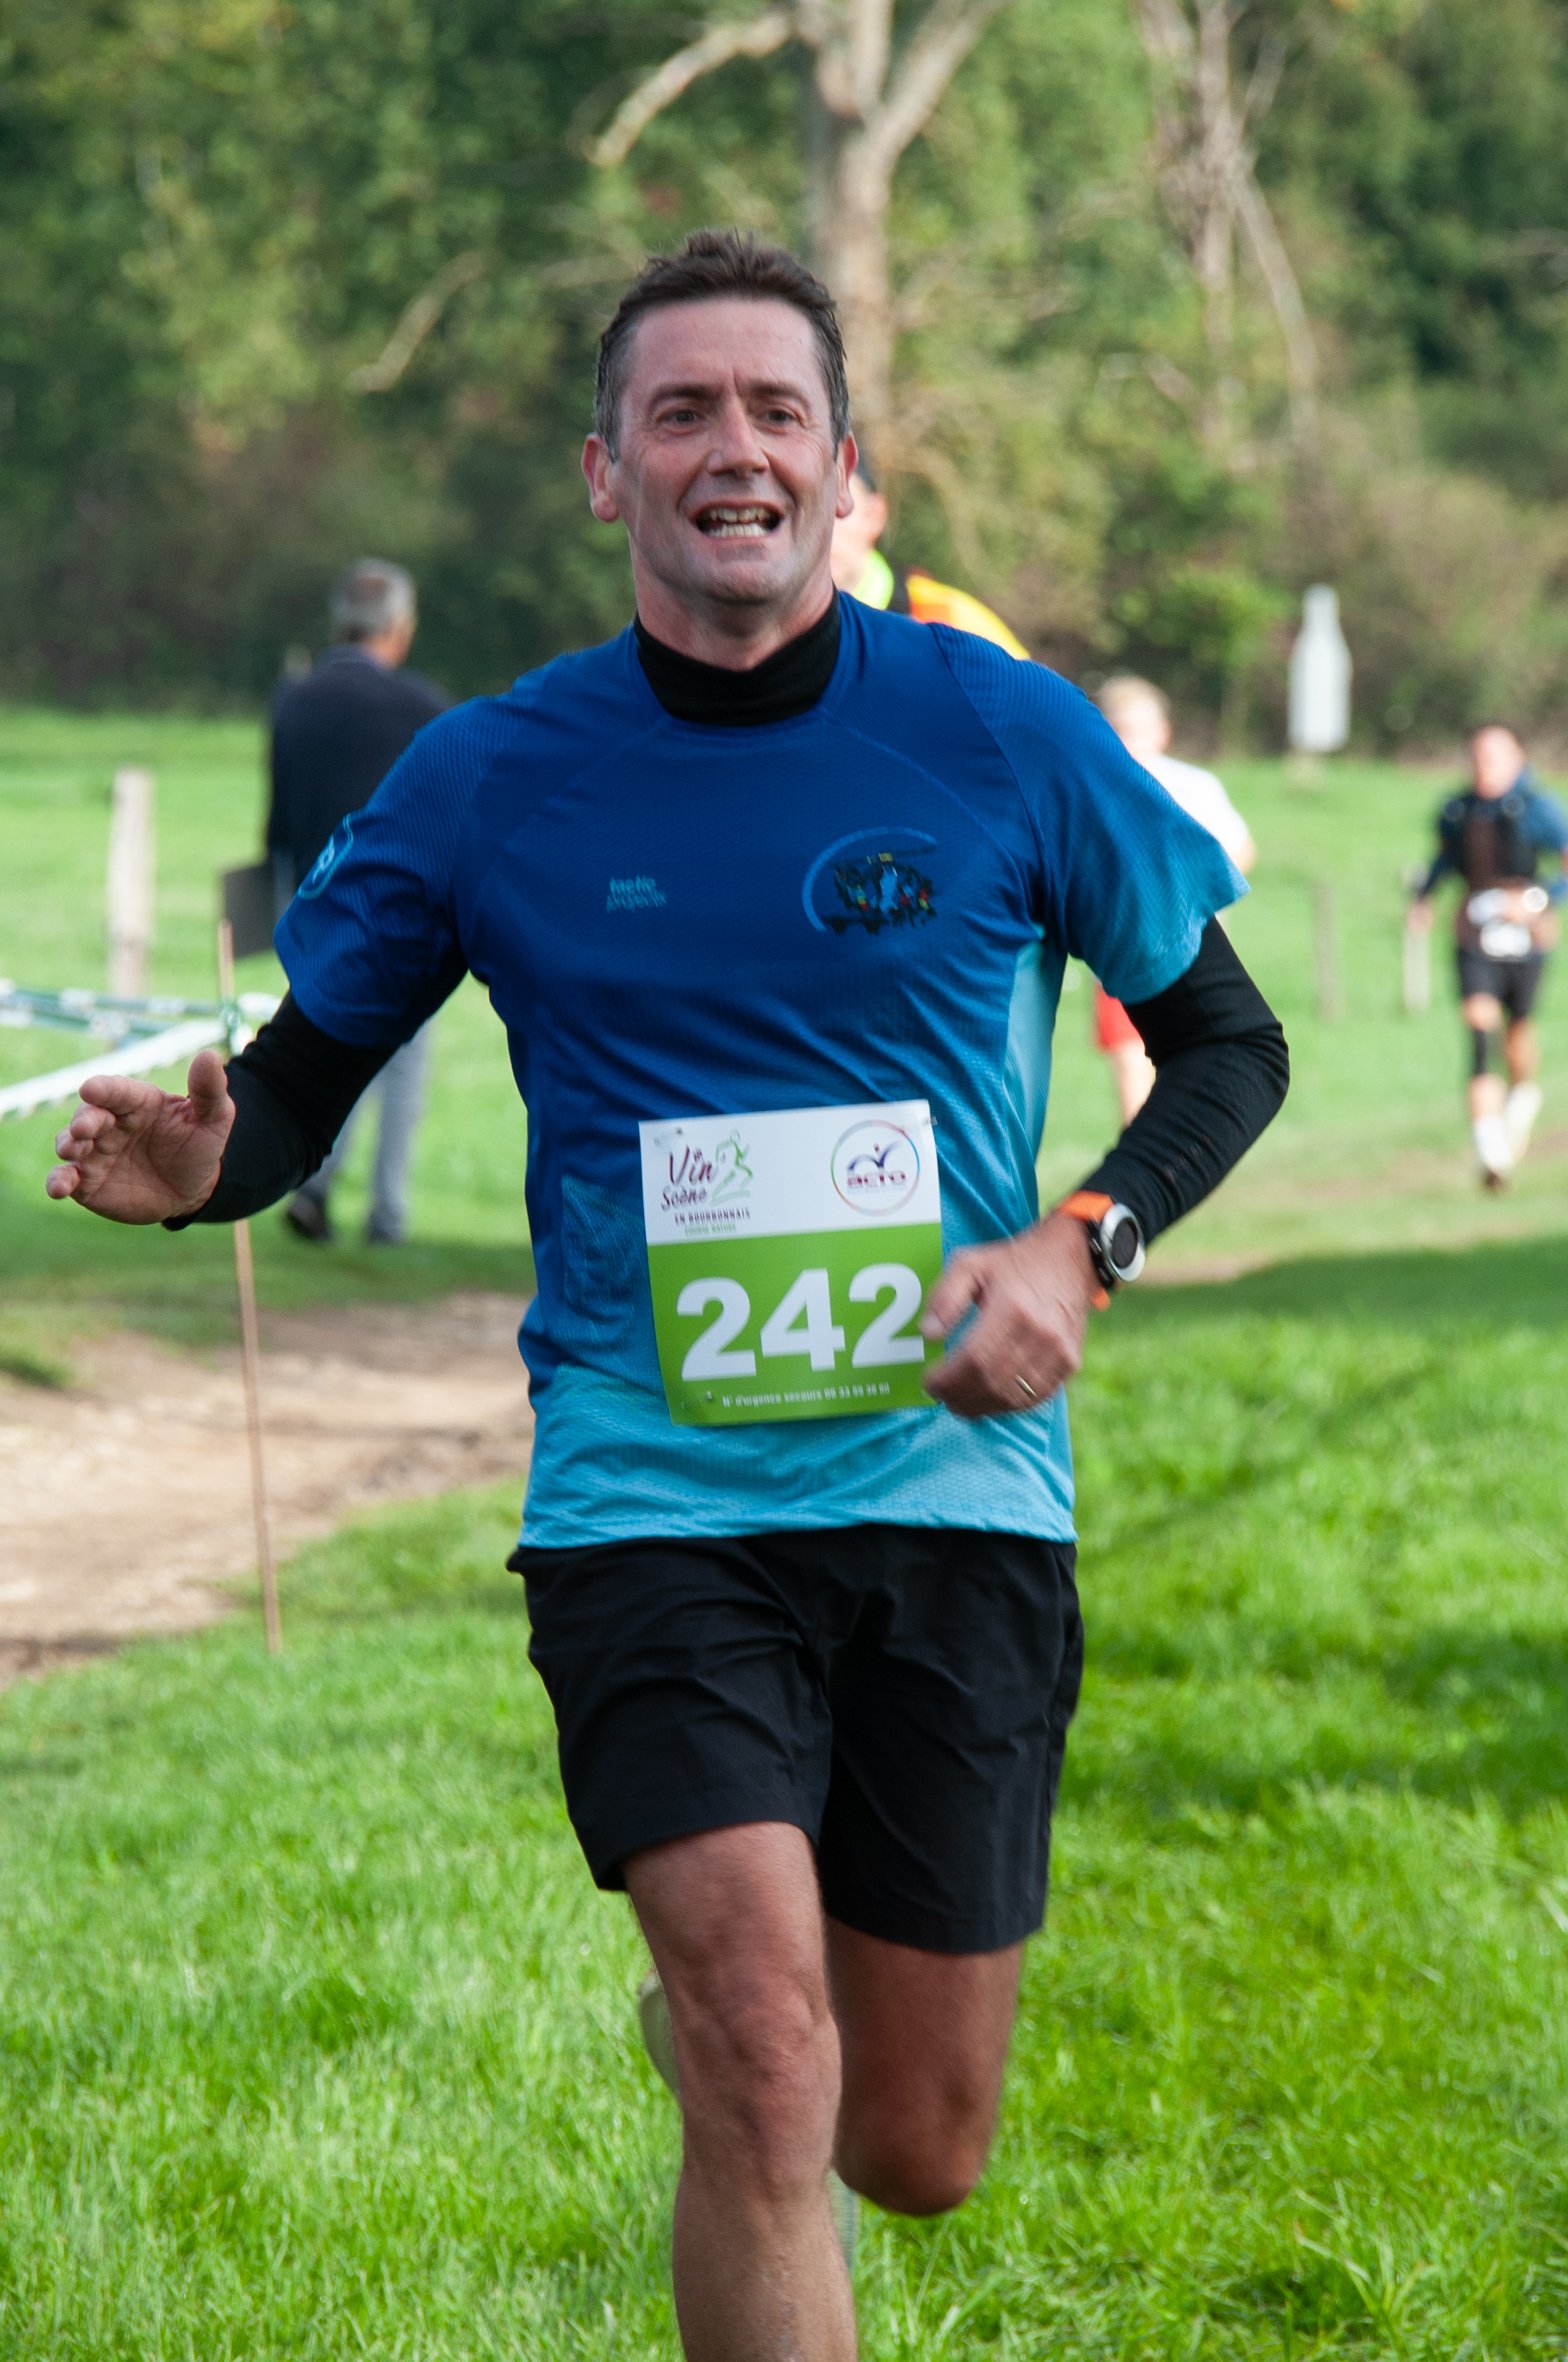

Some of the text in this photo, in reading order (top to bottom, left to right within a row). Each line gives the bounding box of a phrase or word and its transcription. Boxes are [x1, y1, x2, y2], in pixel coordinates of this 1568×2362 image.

[674, 1206, 751, 1226] EN BOURBONNAIS
[675, 1262, 926, 1382] 242
